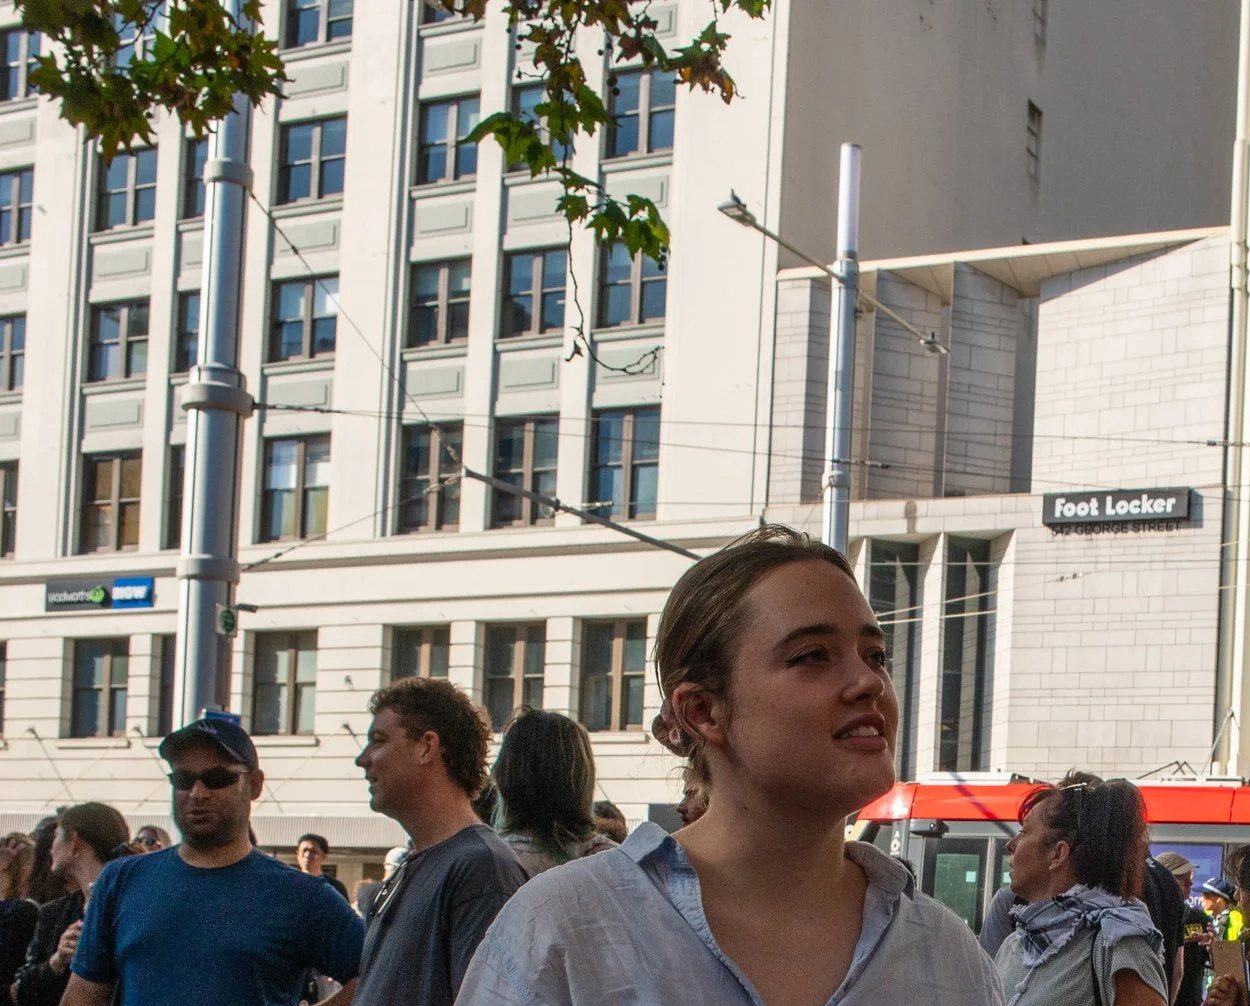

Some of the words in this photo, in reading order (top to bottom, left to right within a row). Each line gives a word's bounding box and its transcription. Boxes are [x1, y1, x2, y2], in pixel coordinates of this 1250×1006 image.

[1054, 496, 1099, 519] Foot
[1105, 493, 1176, 516] Locker
[1074, 522, 1129, 536] GEORGE
[1131, 520, 1181, 532] STREET
